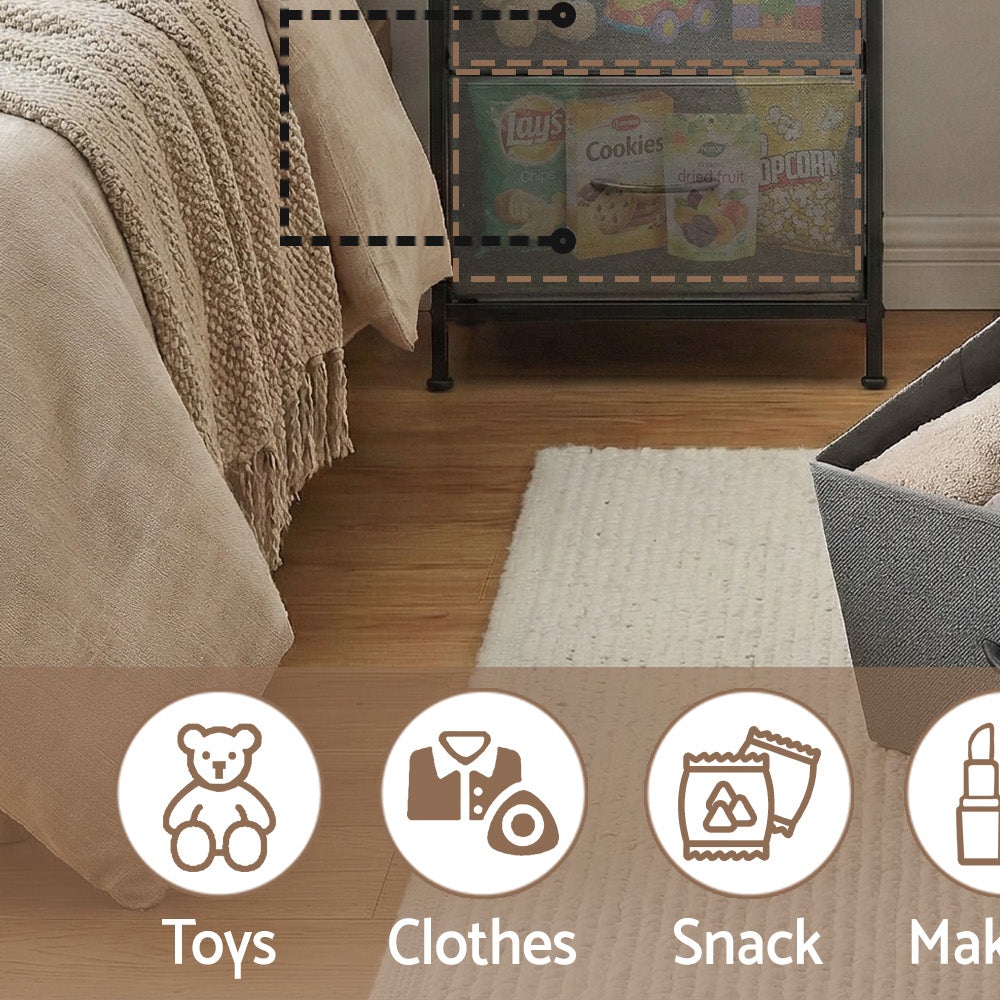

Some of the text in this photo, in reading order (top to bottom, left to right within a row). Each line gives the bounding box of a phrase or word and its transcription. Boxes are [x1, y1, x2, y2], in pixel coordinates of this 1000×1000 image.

[506, 108, 564, 147] Lay's
[586, 134, 664, 162] Cookies
[520, 169, 556, 184] Chips
[678, 168, 745, 184] dried fruit
[760, 151, 838, 185] OPCORN
